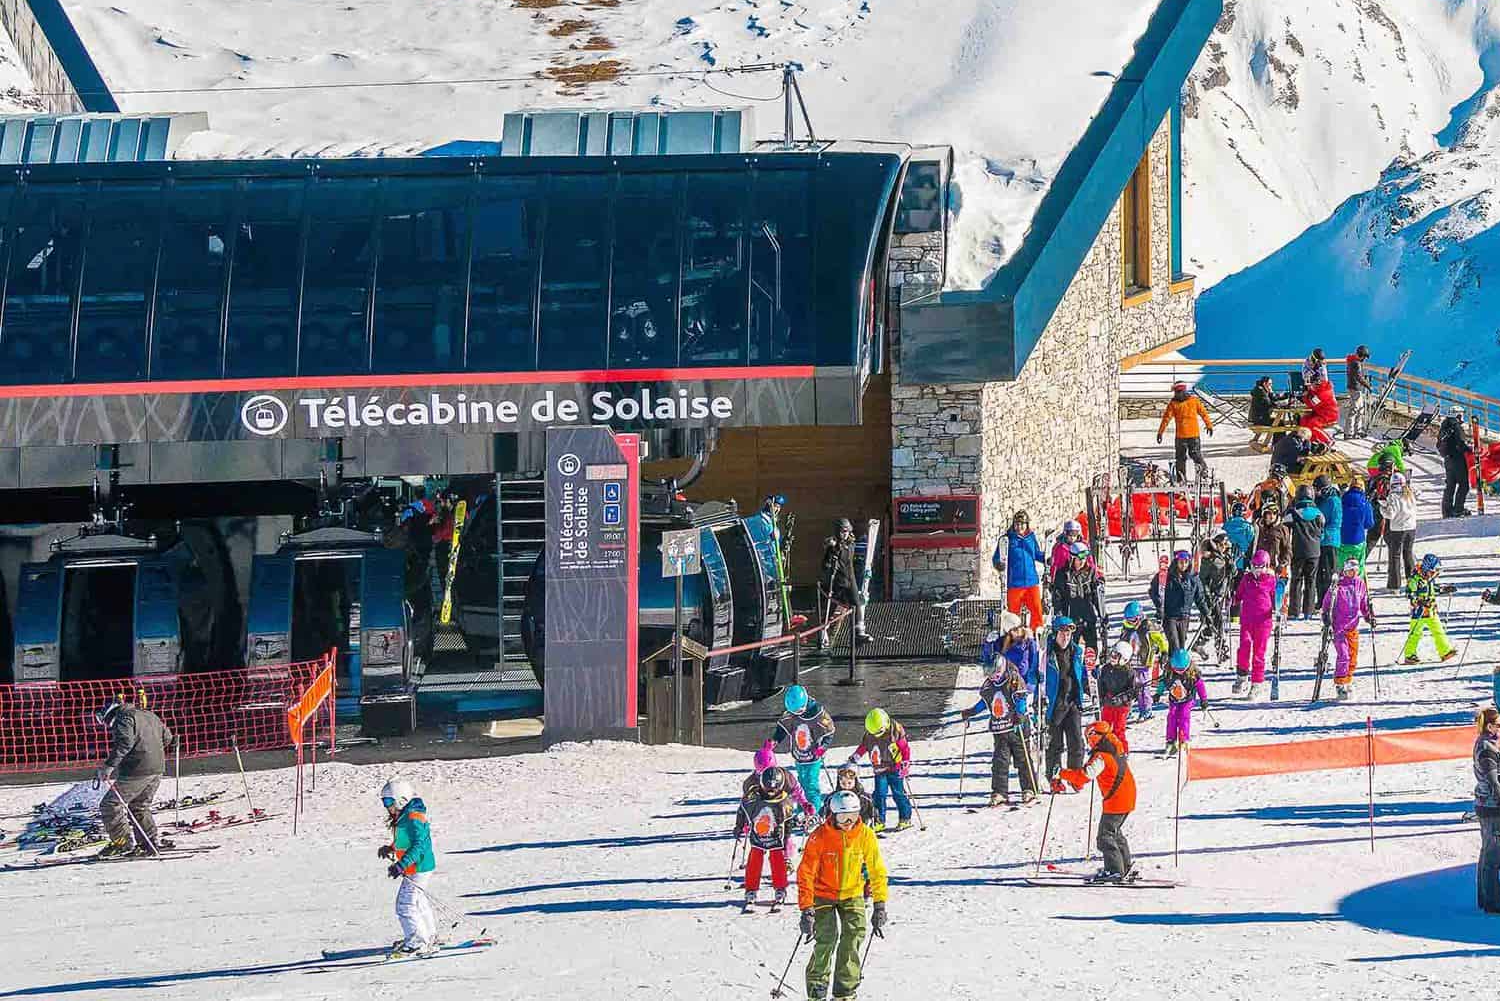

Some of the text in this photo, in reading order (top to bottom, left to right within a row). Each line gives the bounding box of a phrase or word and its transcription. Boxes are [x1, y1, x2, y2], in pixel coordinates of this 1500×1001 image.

[299, 388, 733, 428] Télécabine de Solaise
[560, 482, 573, 559] Télécabine
[575, 487, 588, 558] de Solaise
